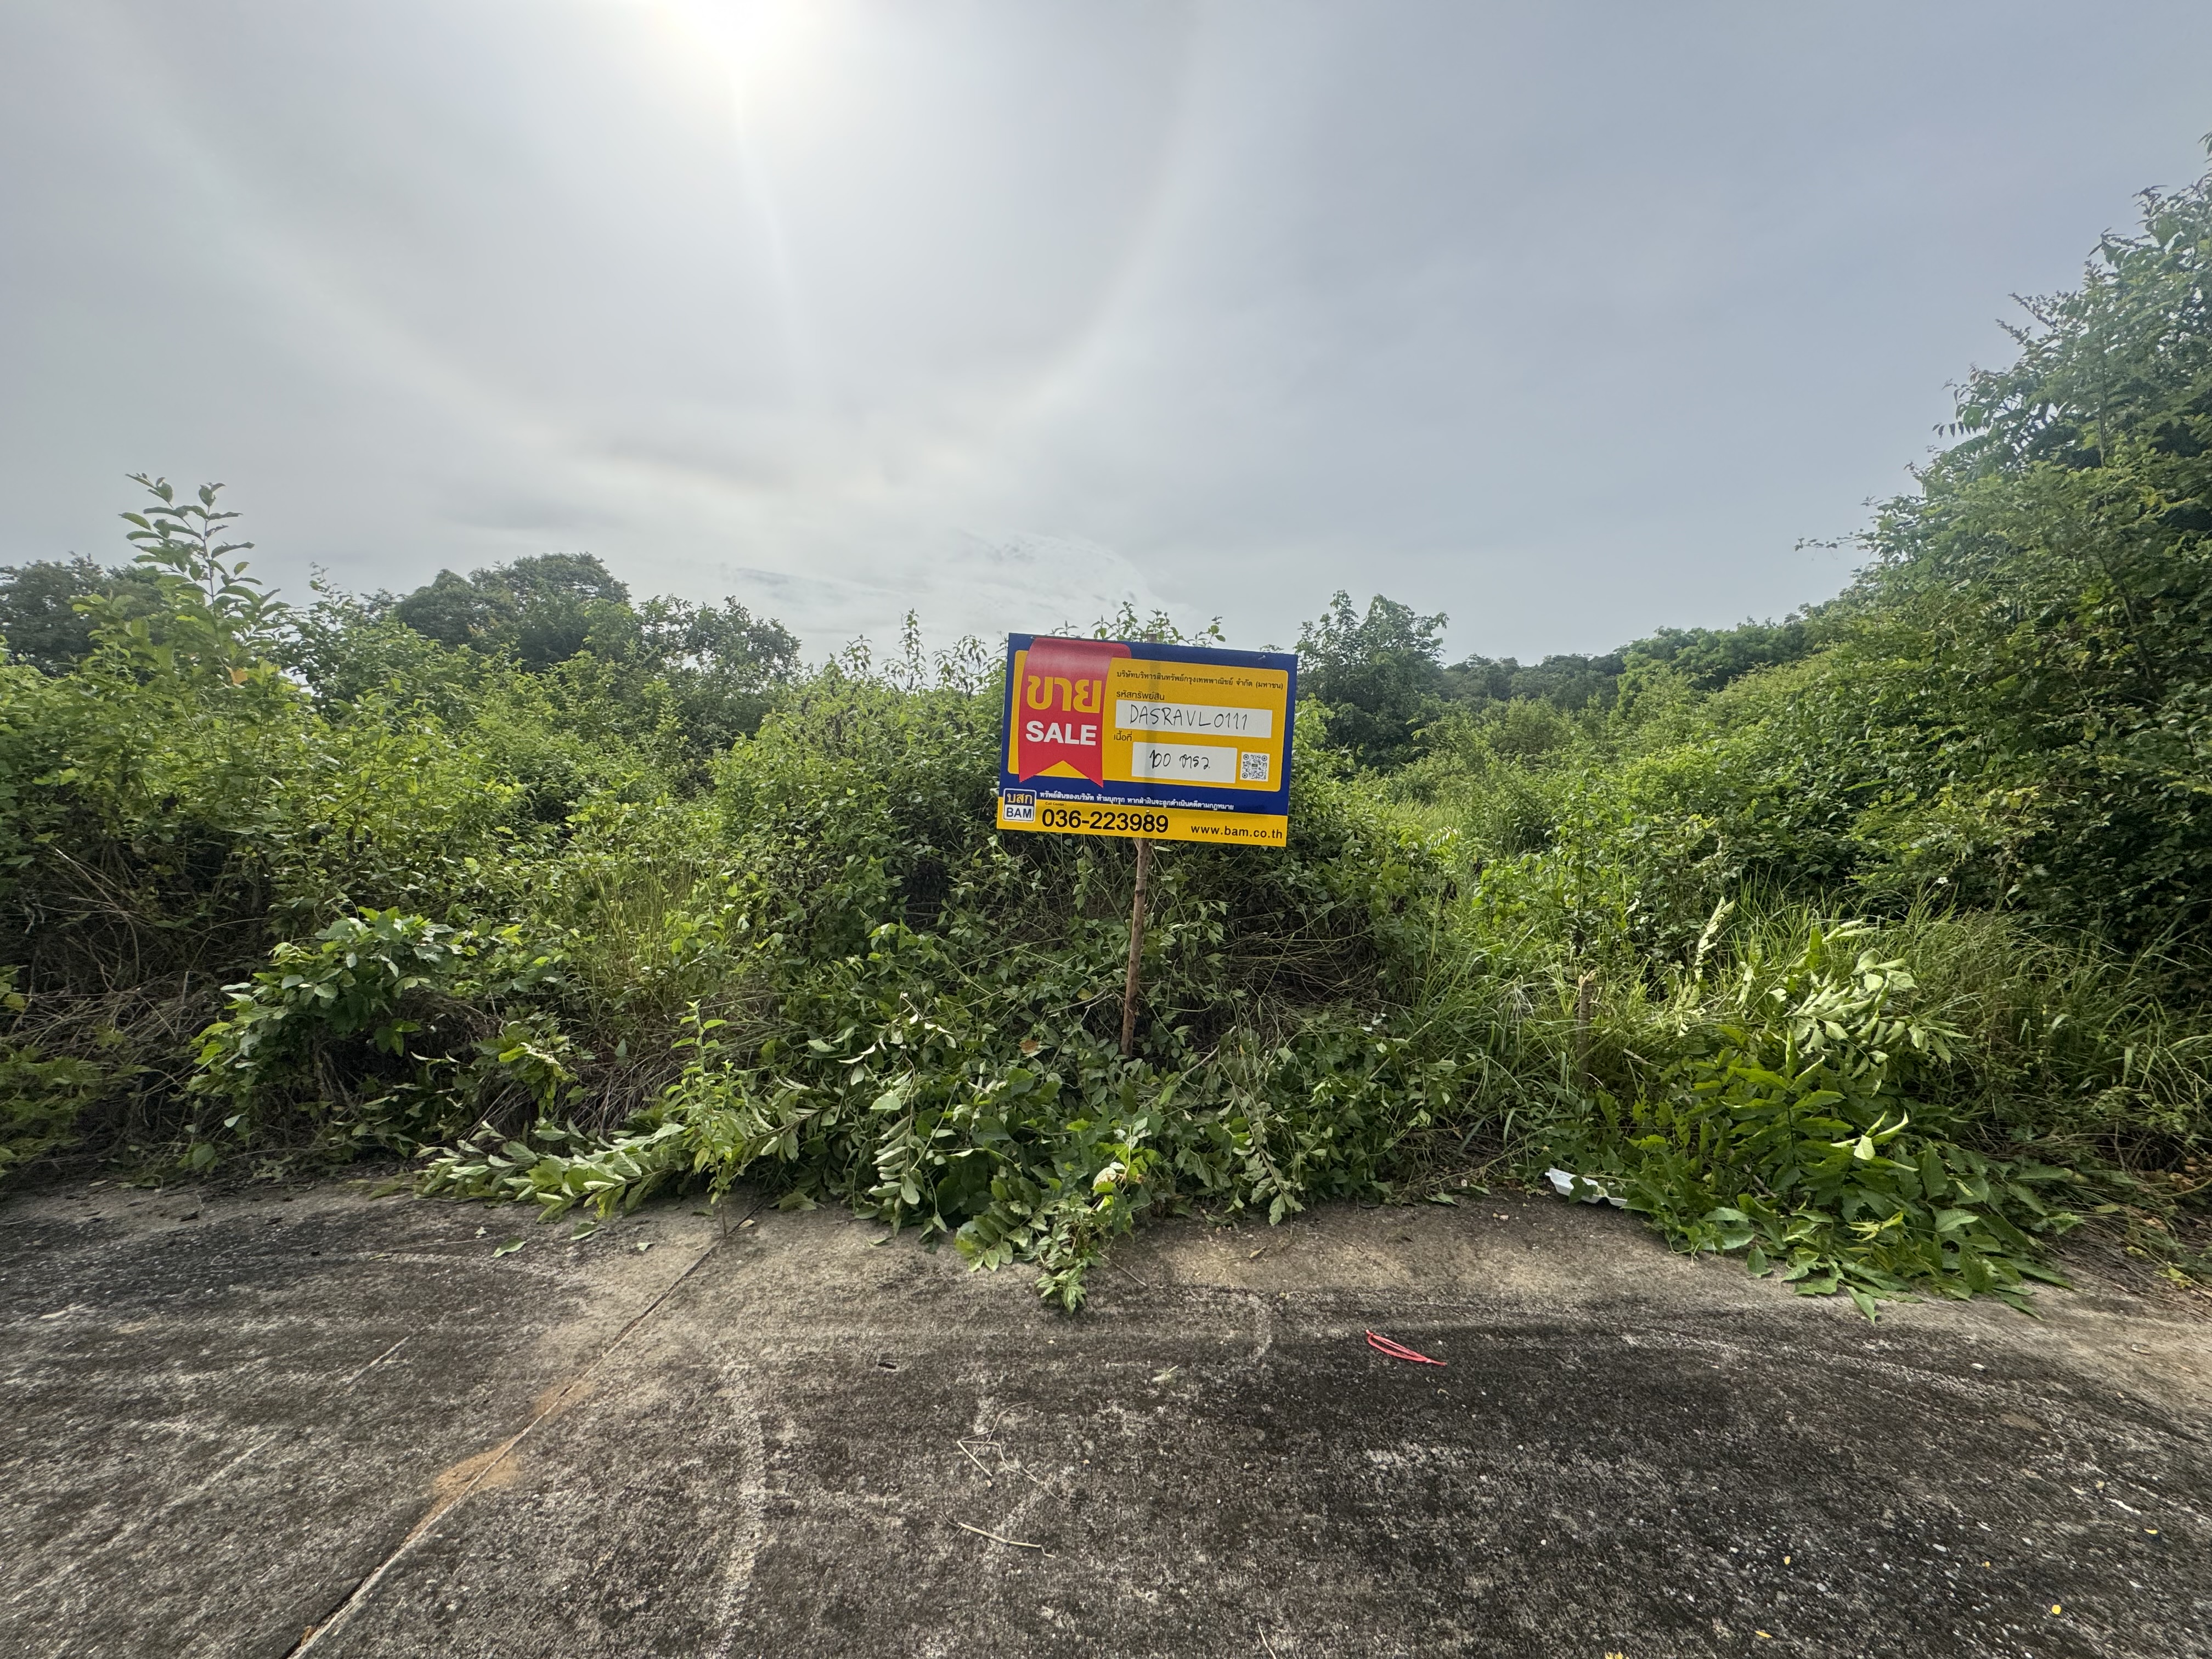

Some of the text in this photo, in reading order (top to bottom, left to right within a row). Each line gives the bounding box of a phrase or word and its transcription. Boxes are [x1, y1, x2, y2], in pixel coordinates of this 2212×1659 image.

[1116, 670, 1284, 690] บริษัทบริหารสินทรัพย์กรุงเทพพาณิชย์ จำกัด (มหาชน)
[1027, 675, 1102, 714] ขาย
[1116, 690, 1165, 701] รหัสทรัพย์สิน
[1025, 720, 1097, 746] SALE
[1114, 730, 1132, 741] เนื้อที่
[1149, 749, 1171, 769] 100
[1007, 792, 1033, 805] บสก
[1040, 791, 1094, 802] ทรัพย์สินของบริษัท
[1097, 794, 1125, 805] ห้ามบุกรุก
[1006, 808, 1032, 819] BAM
[1042, 809, 1169, 833] 036-223989
[1190, 825, 1283, 839] www.bam.co.th
